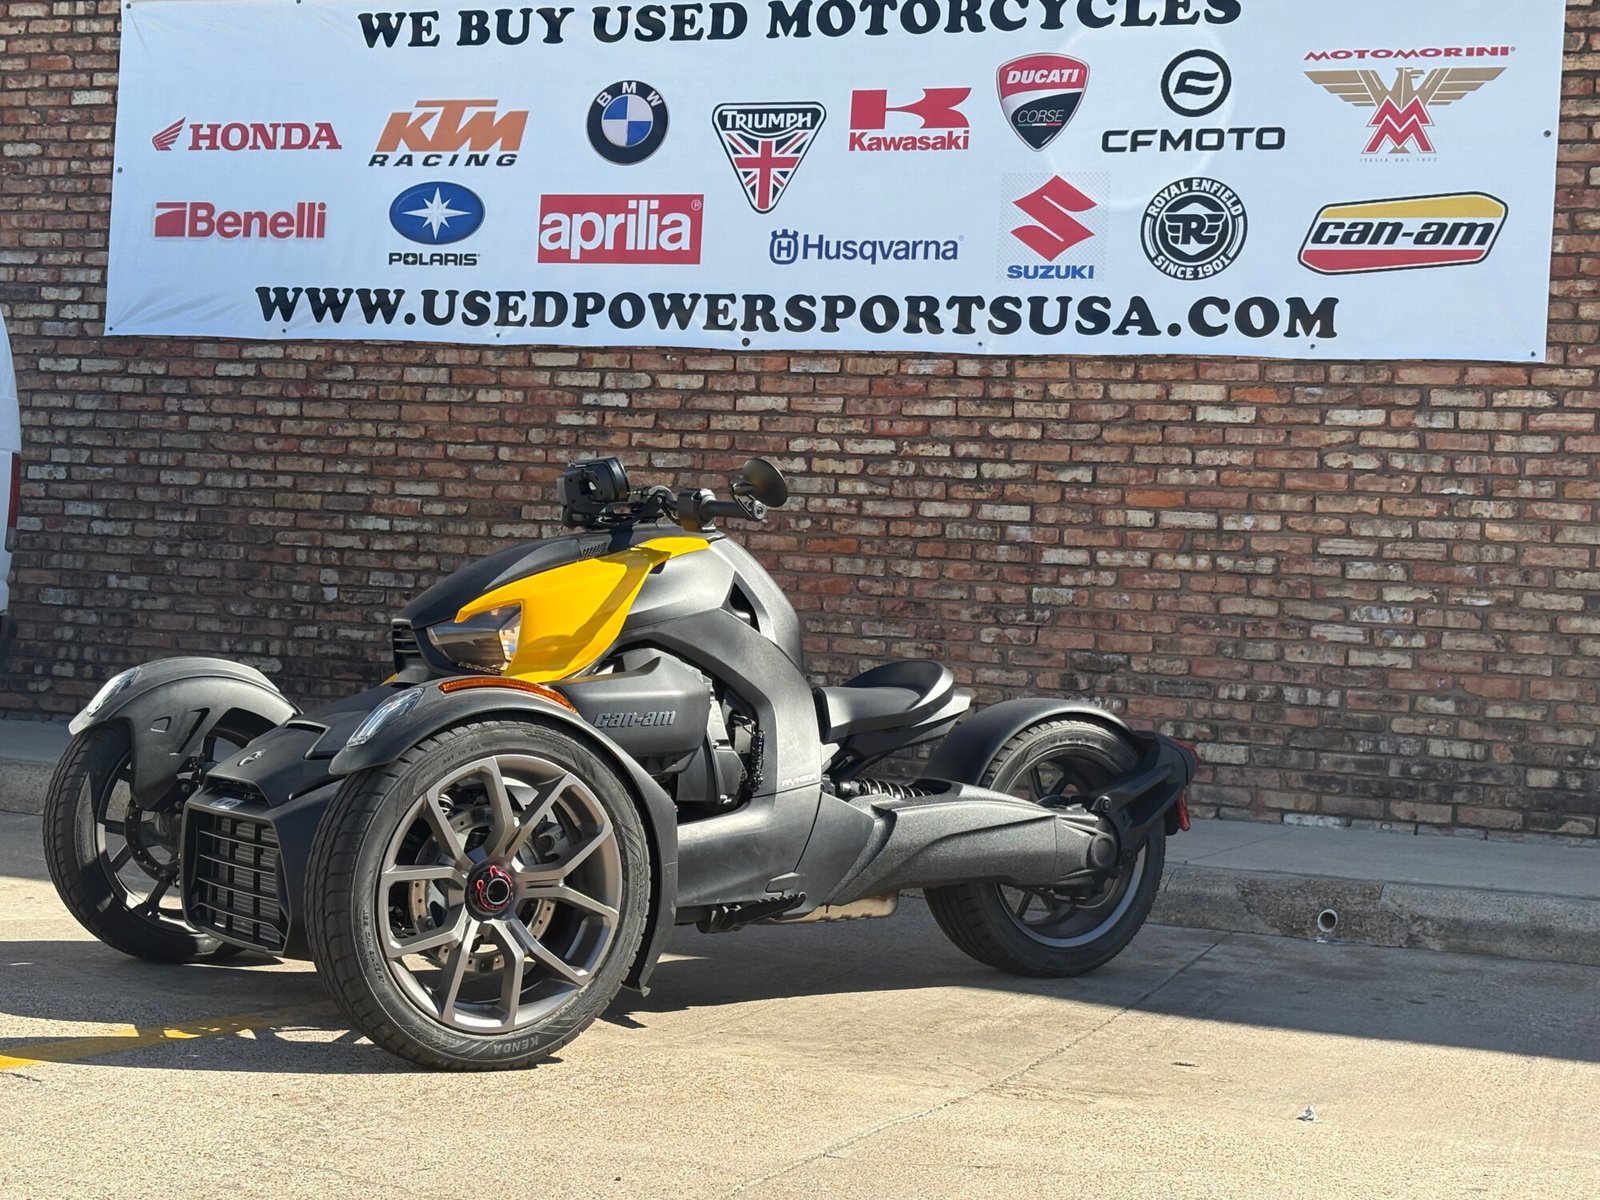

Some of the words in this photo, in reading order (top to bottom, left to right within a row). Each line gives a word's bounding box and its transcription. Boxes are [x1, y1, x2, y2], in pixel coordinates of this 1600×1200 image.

[358, 10, 440, 48] WE
[456, 7, 575, 47] BUY
[593, 1, 749, 43] USED
[766, 0, 1241, 38] MOTORCYCLES
[1006, 68, 1081, 85] DUCATI
[596, 81, 663, 108] BMW
[374, 98, 530, 152] KTM
[722, 111, 812, 128] TRIUMPH
[1016, 109, 1065, 123] CORSE
[188, 122, 342, 151] HONDA
[849, 130, 969, 151] Kawasaki
[1101, 127, 1286, 152] CFMOTO
[368, 153, 518, 167] RACING
[1147, 181, 1189, 217] ROYAL
[1192, 179, 1244, 216] ENFIELD
[187, 202, 327, 239] Benelli
[540, 200, 691, 260] aprilia
[1310, 221, 1495, 246] can-am
[388, 252, 479, 267] POLARIS
[802, 234, 958, 265] Husqvarna
[1007, 264, 1094, 280] SUZUKI
[1153, 256, 1194, 279] SINCE
[1197, 255, 1231, 278] 1901
[255, 287, 1339, 338] WWW.USEDPOWERSPORTSUSA.COM
[593, 710, 676, 728] can-am
[493, 1035, 539, 1055] KENDA
